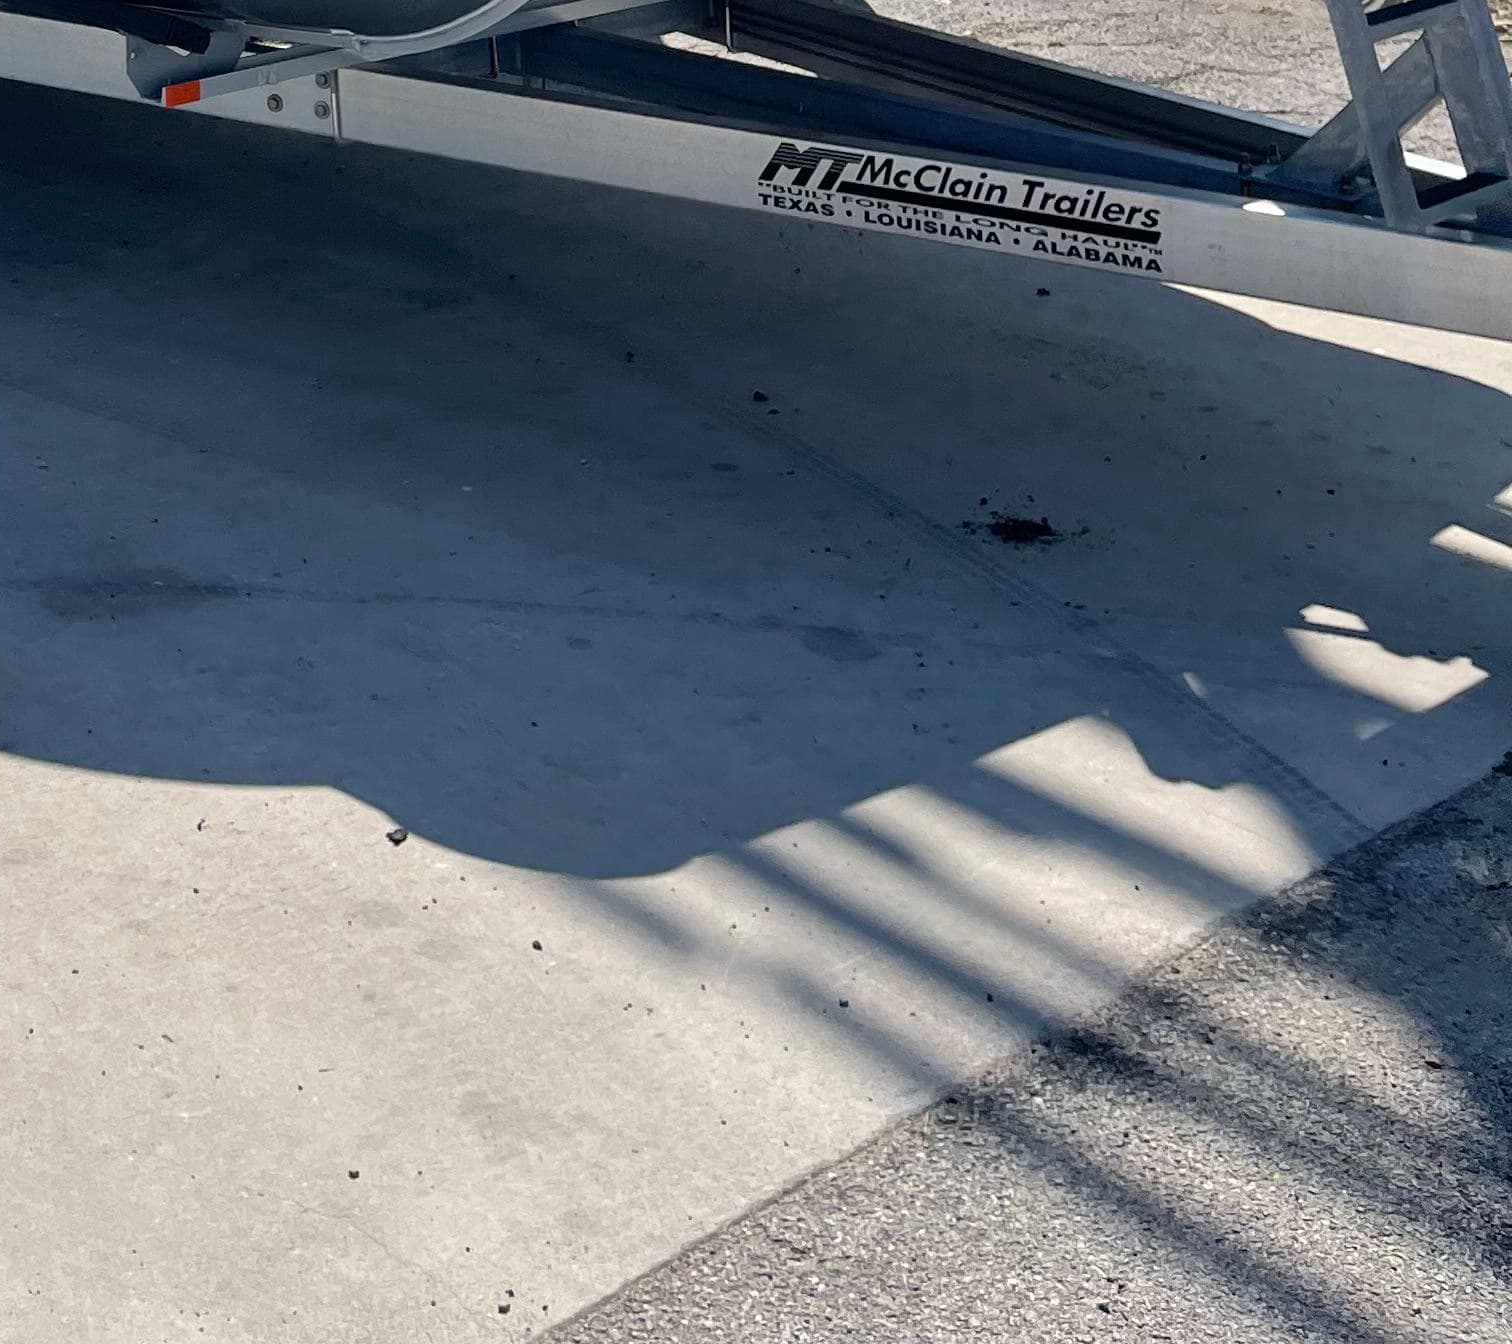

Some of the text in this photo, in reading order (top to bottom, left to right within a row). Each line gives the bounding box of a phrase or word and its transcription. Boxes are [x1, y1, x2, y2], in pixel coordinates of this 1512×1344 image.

[842, 196, 891, 211] FOR
[899, 205, 944, 220] THE
[954, 214, 1049, 237] LONG
[855, 155, 1008, 204] McClain
[1022, 179, 1162, 228] Trailers
[758, 192, 1163, 273] TEXAS LOUISIANA ALABAMA
